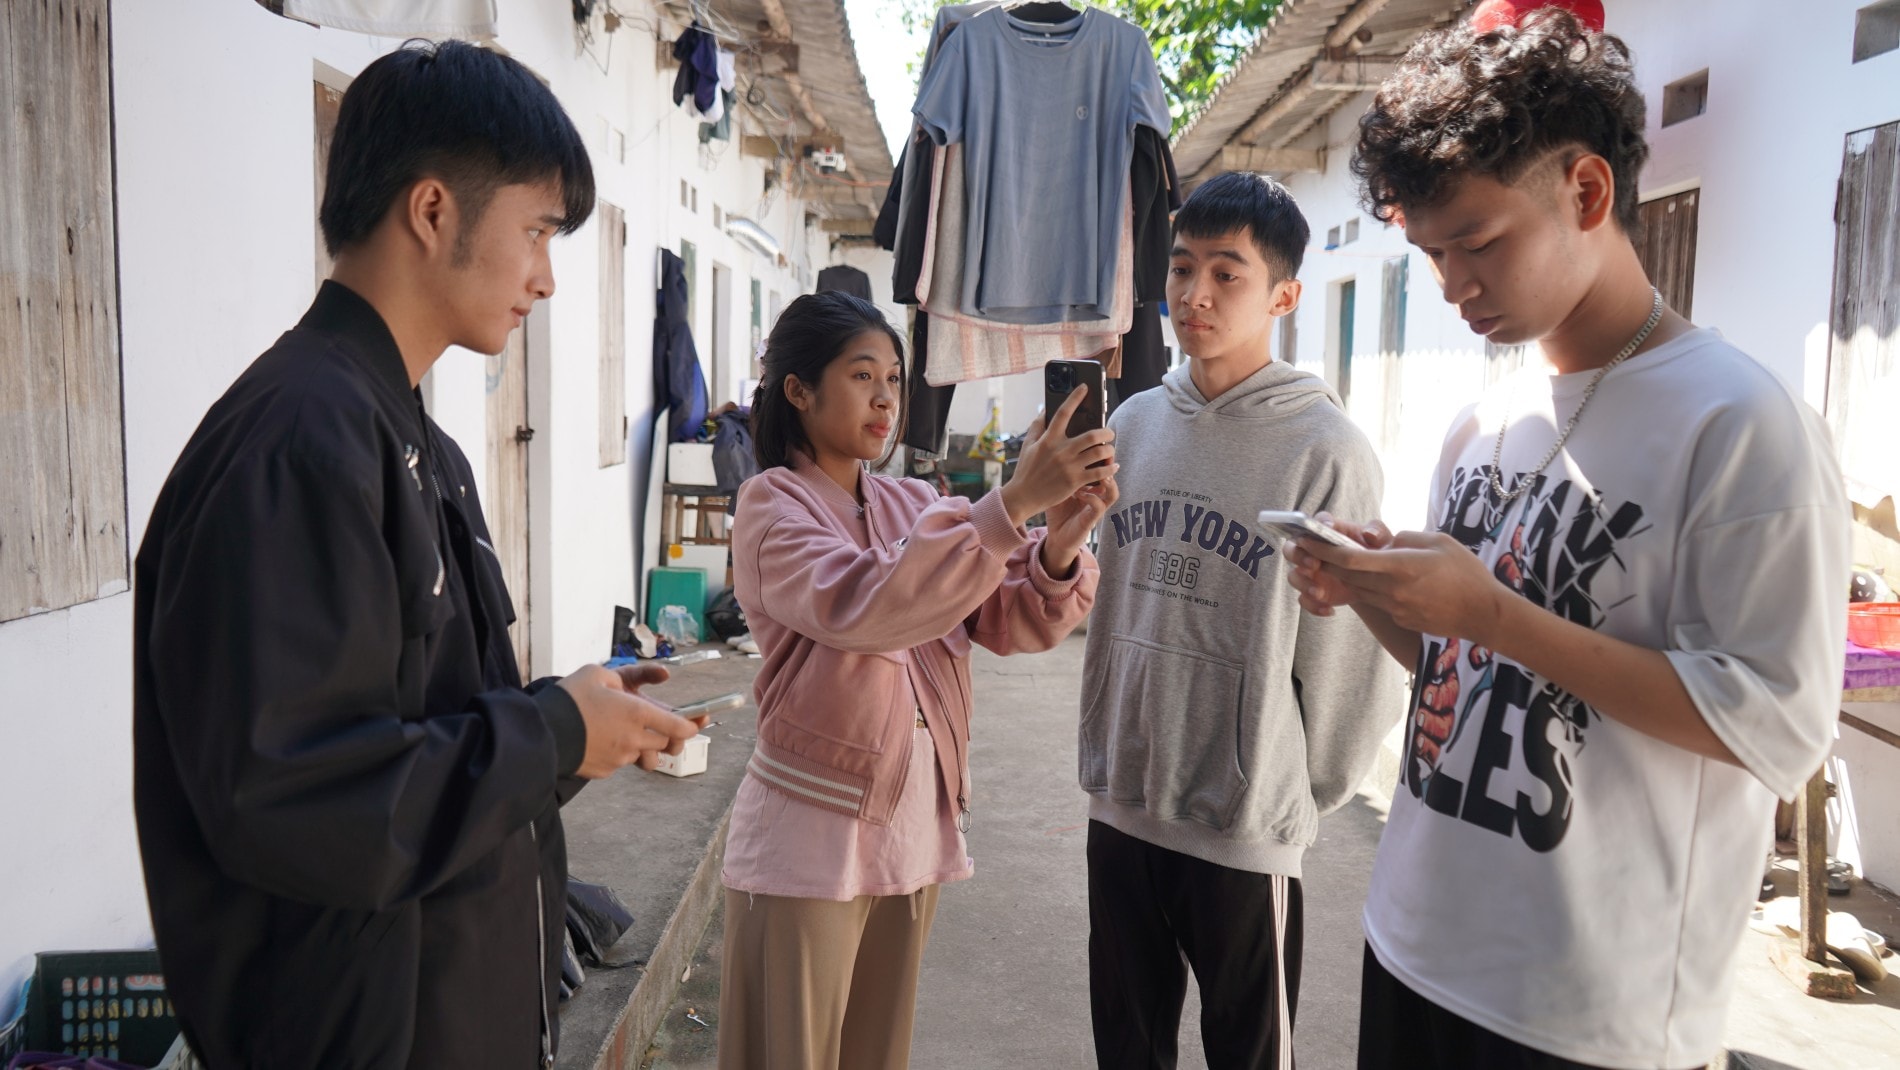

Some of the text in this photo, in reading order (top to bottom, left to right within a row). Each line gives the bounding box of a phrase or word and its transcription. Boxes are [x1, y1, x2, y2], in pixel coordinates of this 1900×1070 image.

[1160, 489, 1181, 497] STATUE
[1191, 493, 1213, 503] LIBERTY
[1111, 500, 1275, 579] NEW YORK
[1148, 549, 1200, 589] 1686
[1167, 591, 1177, 599] ON
[1180, 593, 1193, 602] THE
[1194, 596, 1219, 608] WORLD
